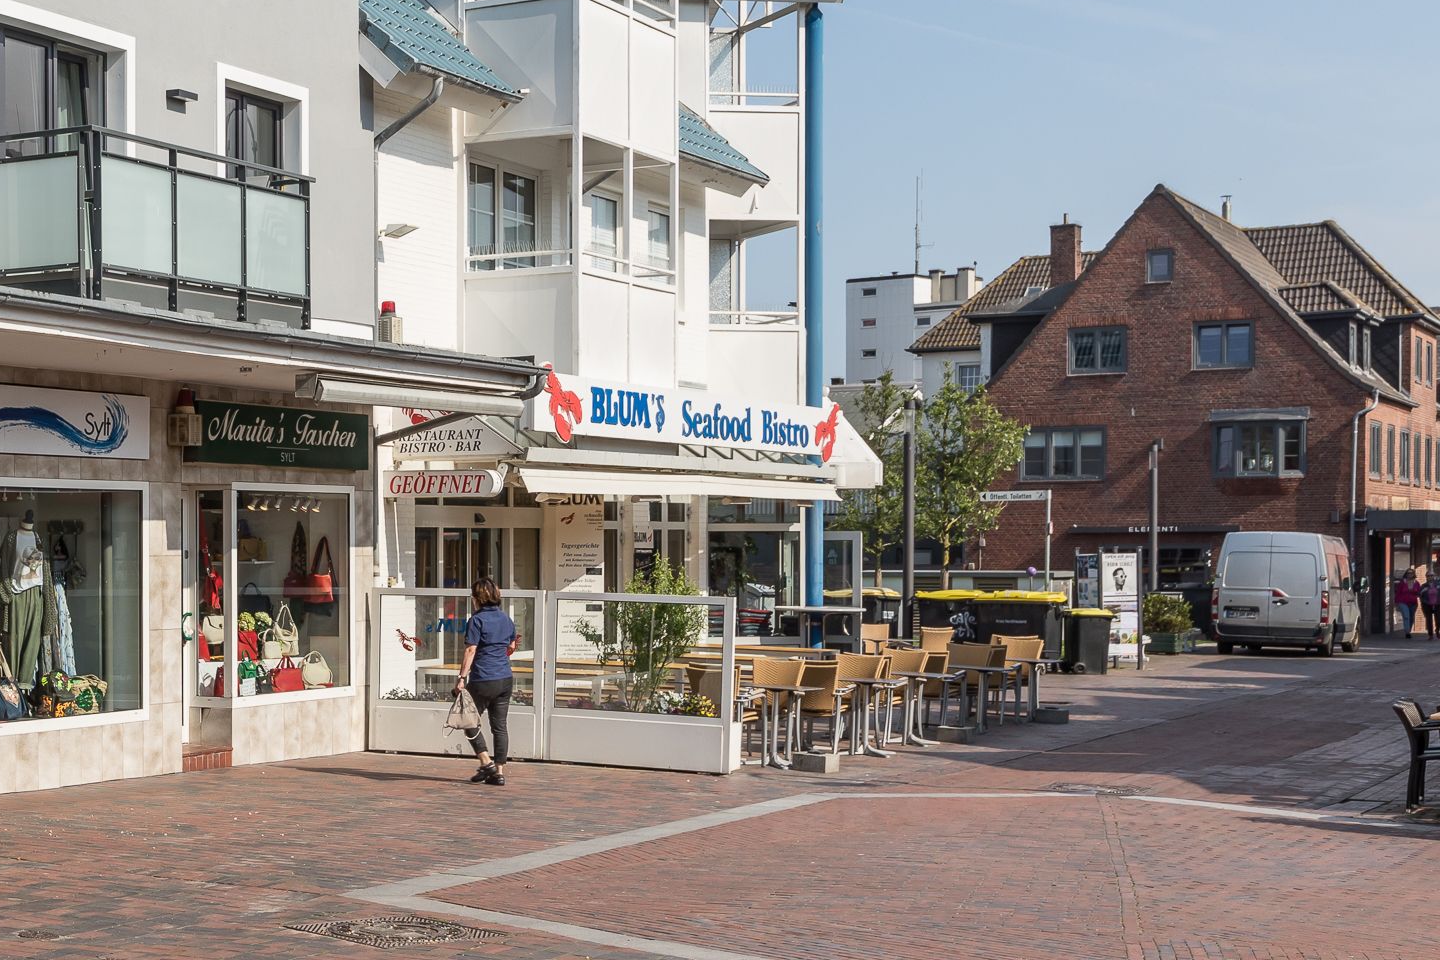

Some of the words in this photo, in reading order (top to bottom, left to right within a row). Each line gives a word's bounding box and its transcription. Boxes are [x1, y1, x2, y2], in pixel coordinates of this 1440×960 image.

[84, 411, 111, 442] Sylt
[208, 409, 284, 444] Marita's
[293, 414, 356, 448] Taschen
[682, 400, 752, 442] Seafood
[761, 410, 809, 448] Bistro
[281, 452, 295, 462] SYLT
[400, 442, 445, 453] BISTRO
[455, 441, 482, 452] BAR
[389, 472, 485, 494] GEÖFFNET
